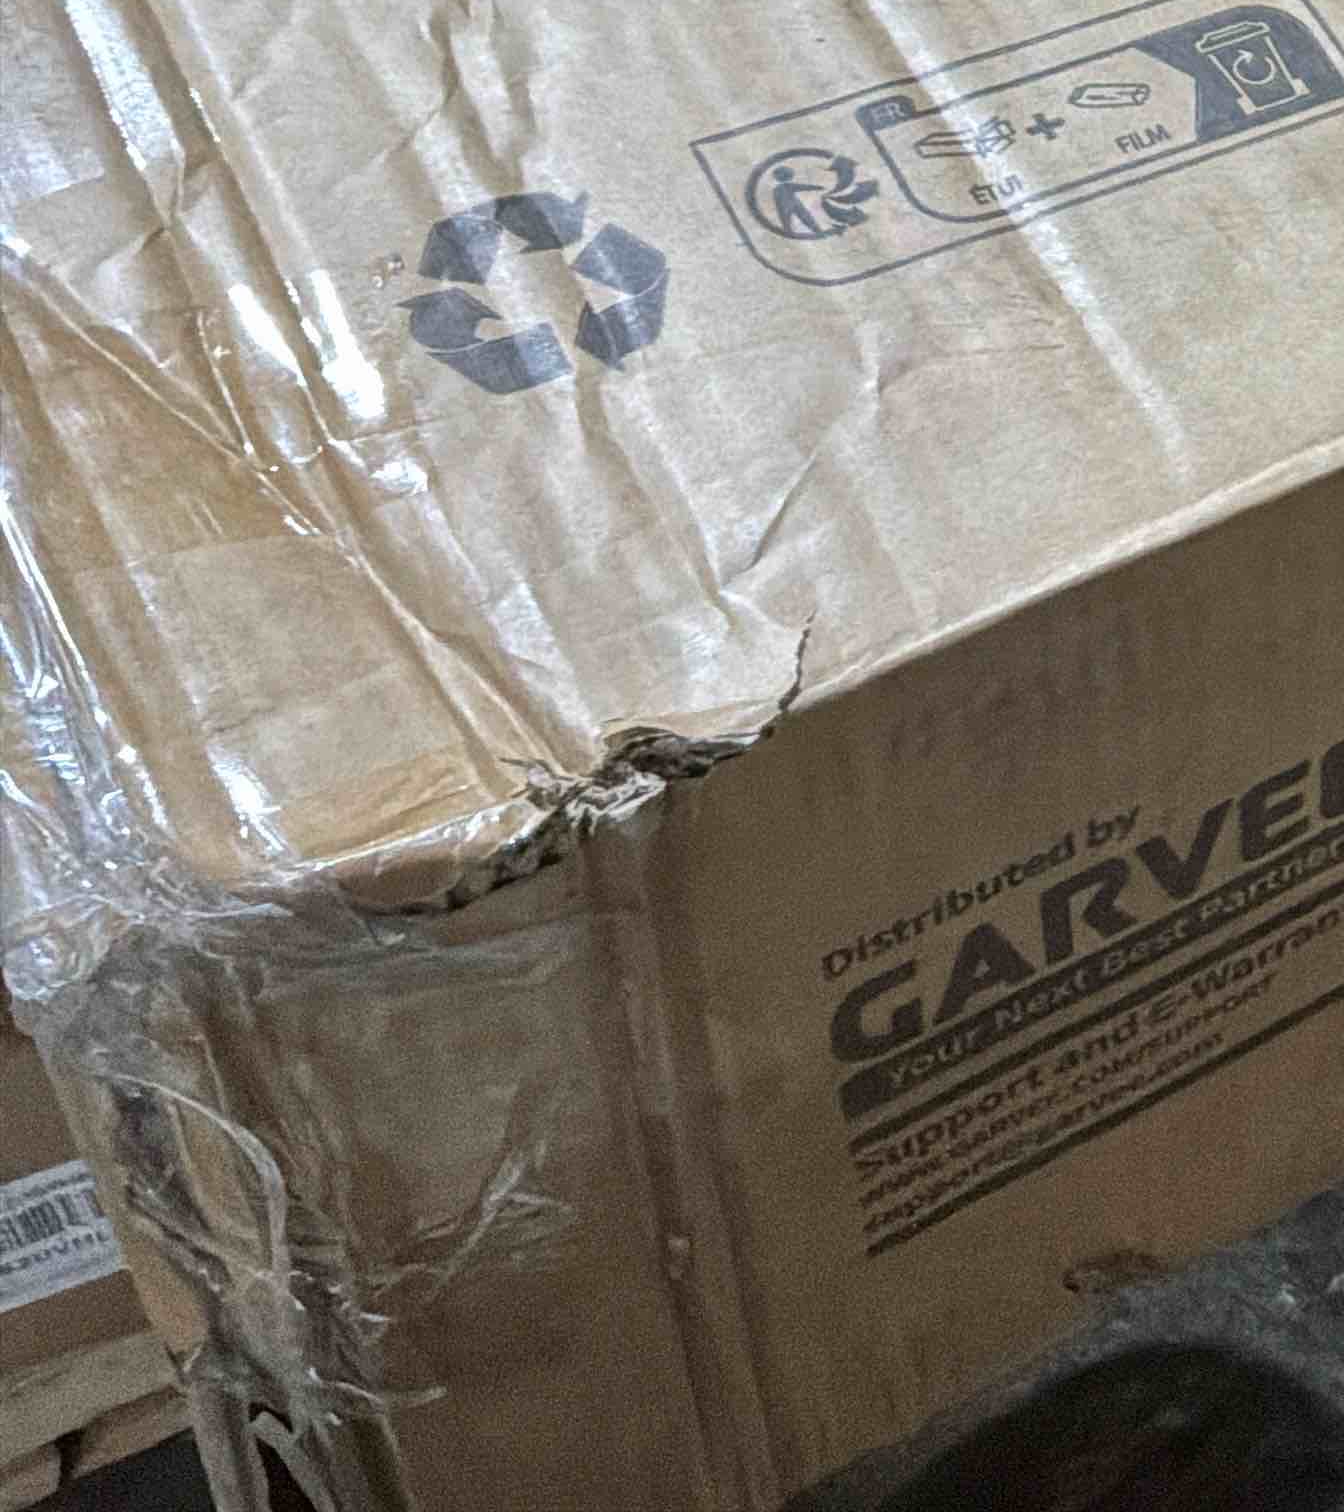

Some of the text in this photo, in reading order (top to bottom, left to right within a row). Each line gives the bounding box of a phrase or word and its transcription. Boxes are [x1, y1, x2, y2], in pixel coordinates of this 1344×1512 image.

[1114, 122, 1171, 155] FILM
[822, 804, 1141, 981] Distributed by
[892, 1030, 977, 1086] Your
[993, 969, 1087, 1026] Next
[1102, 918, 1190, 980] Best
[856, 1070, 1043, 1180] Support
[1053, 1013, 1140, 1078] and
